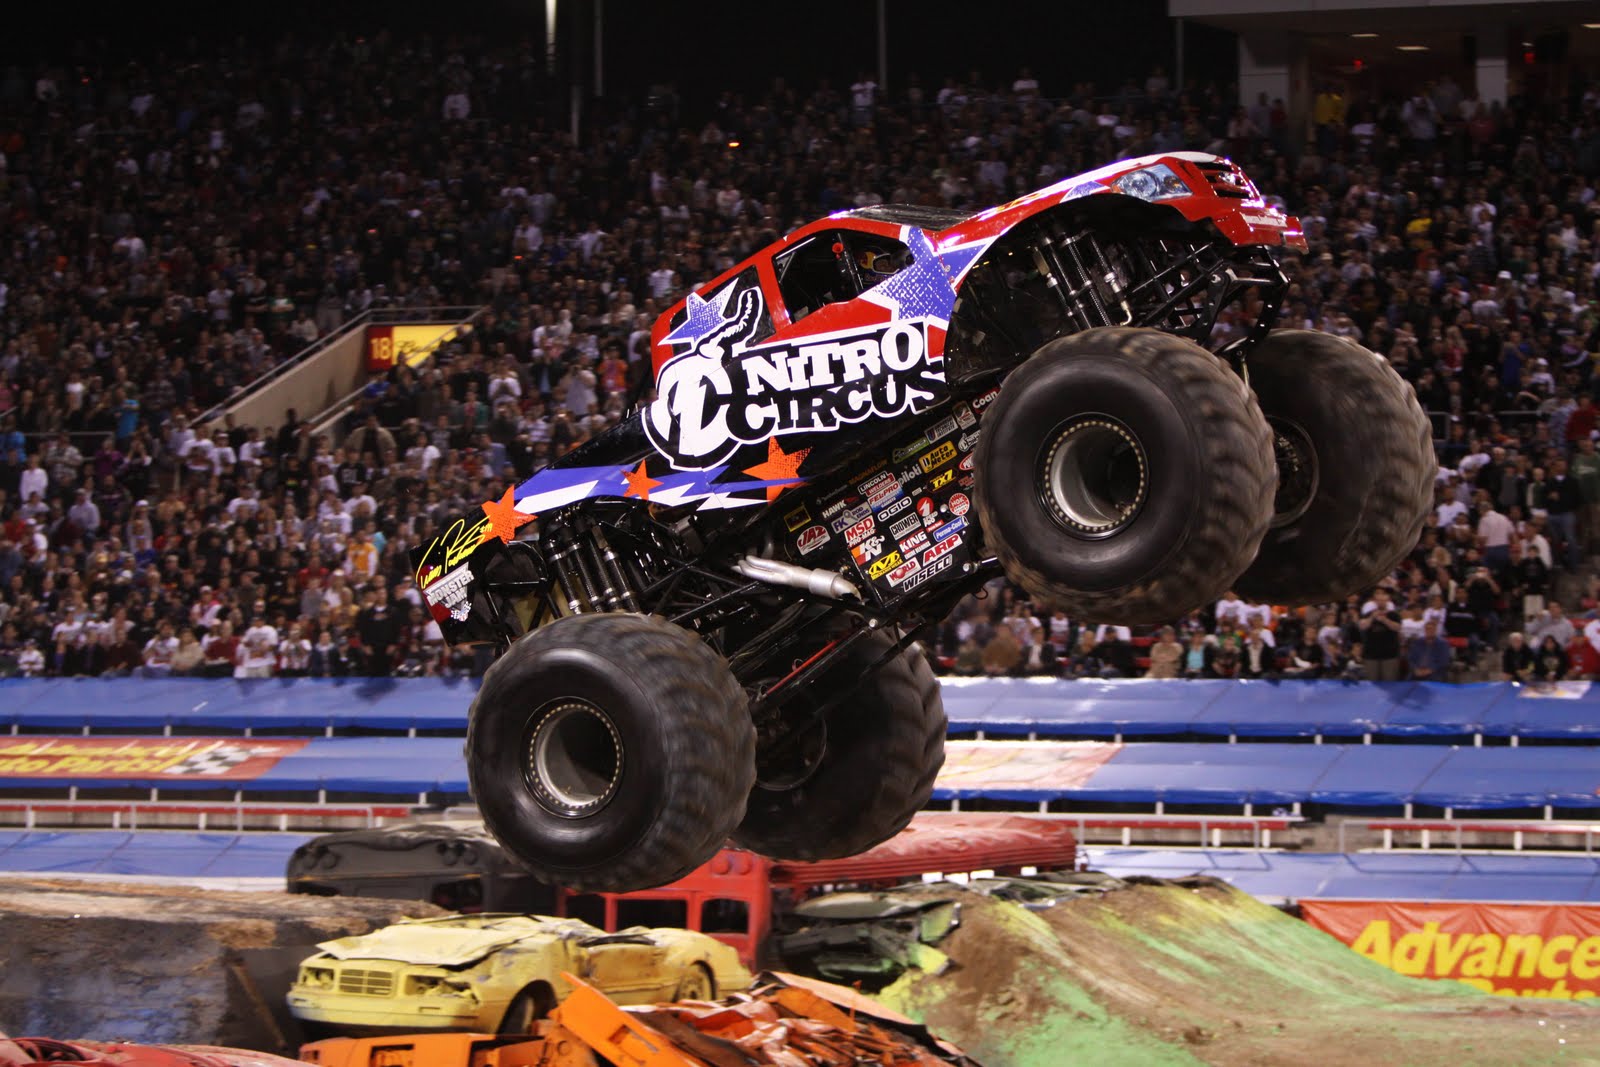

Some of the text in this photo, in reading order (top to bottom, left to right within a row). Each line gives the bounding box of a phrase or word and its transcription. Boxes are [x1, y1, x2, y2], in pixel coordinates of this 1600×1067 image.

[371, 337, 391, 360] 18
[741, 323, 923, 396] NITRO
[725, 360, 948, 442] CIRCUS
[972, 391, 998, 408] Coan
[930, 445, 949, 459] Auto
[931, 449, 954, 468] Meter
[860, 473, 886, 492] LINCOLN
[898, 464, 922, 487] piloti
[822, 500, 847, 519] HAWK
[879, 497, 911, 521] OGIO
[833, 517, 849, 533] FK
[846, 518, 873, 541] MSD
[890, 514, 919, 535] CROWER
[798, 527, 827, 547] JAZ
[899, 531, 928, 553] KING
[860, 535, 886, 562] K&N
[924, 534, 960, 563] ARP
[889, 561, 916, 581] WORLD
[904, 555, 952, 592] WISECO
[427, 570, 475, 606] MONSTER
[444, 588, 468, 609] JAM
[1351, 918, 1600, 979] Advance
